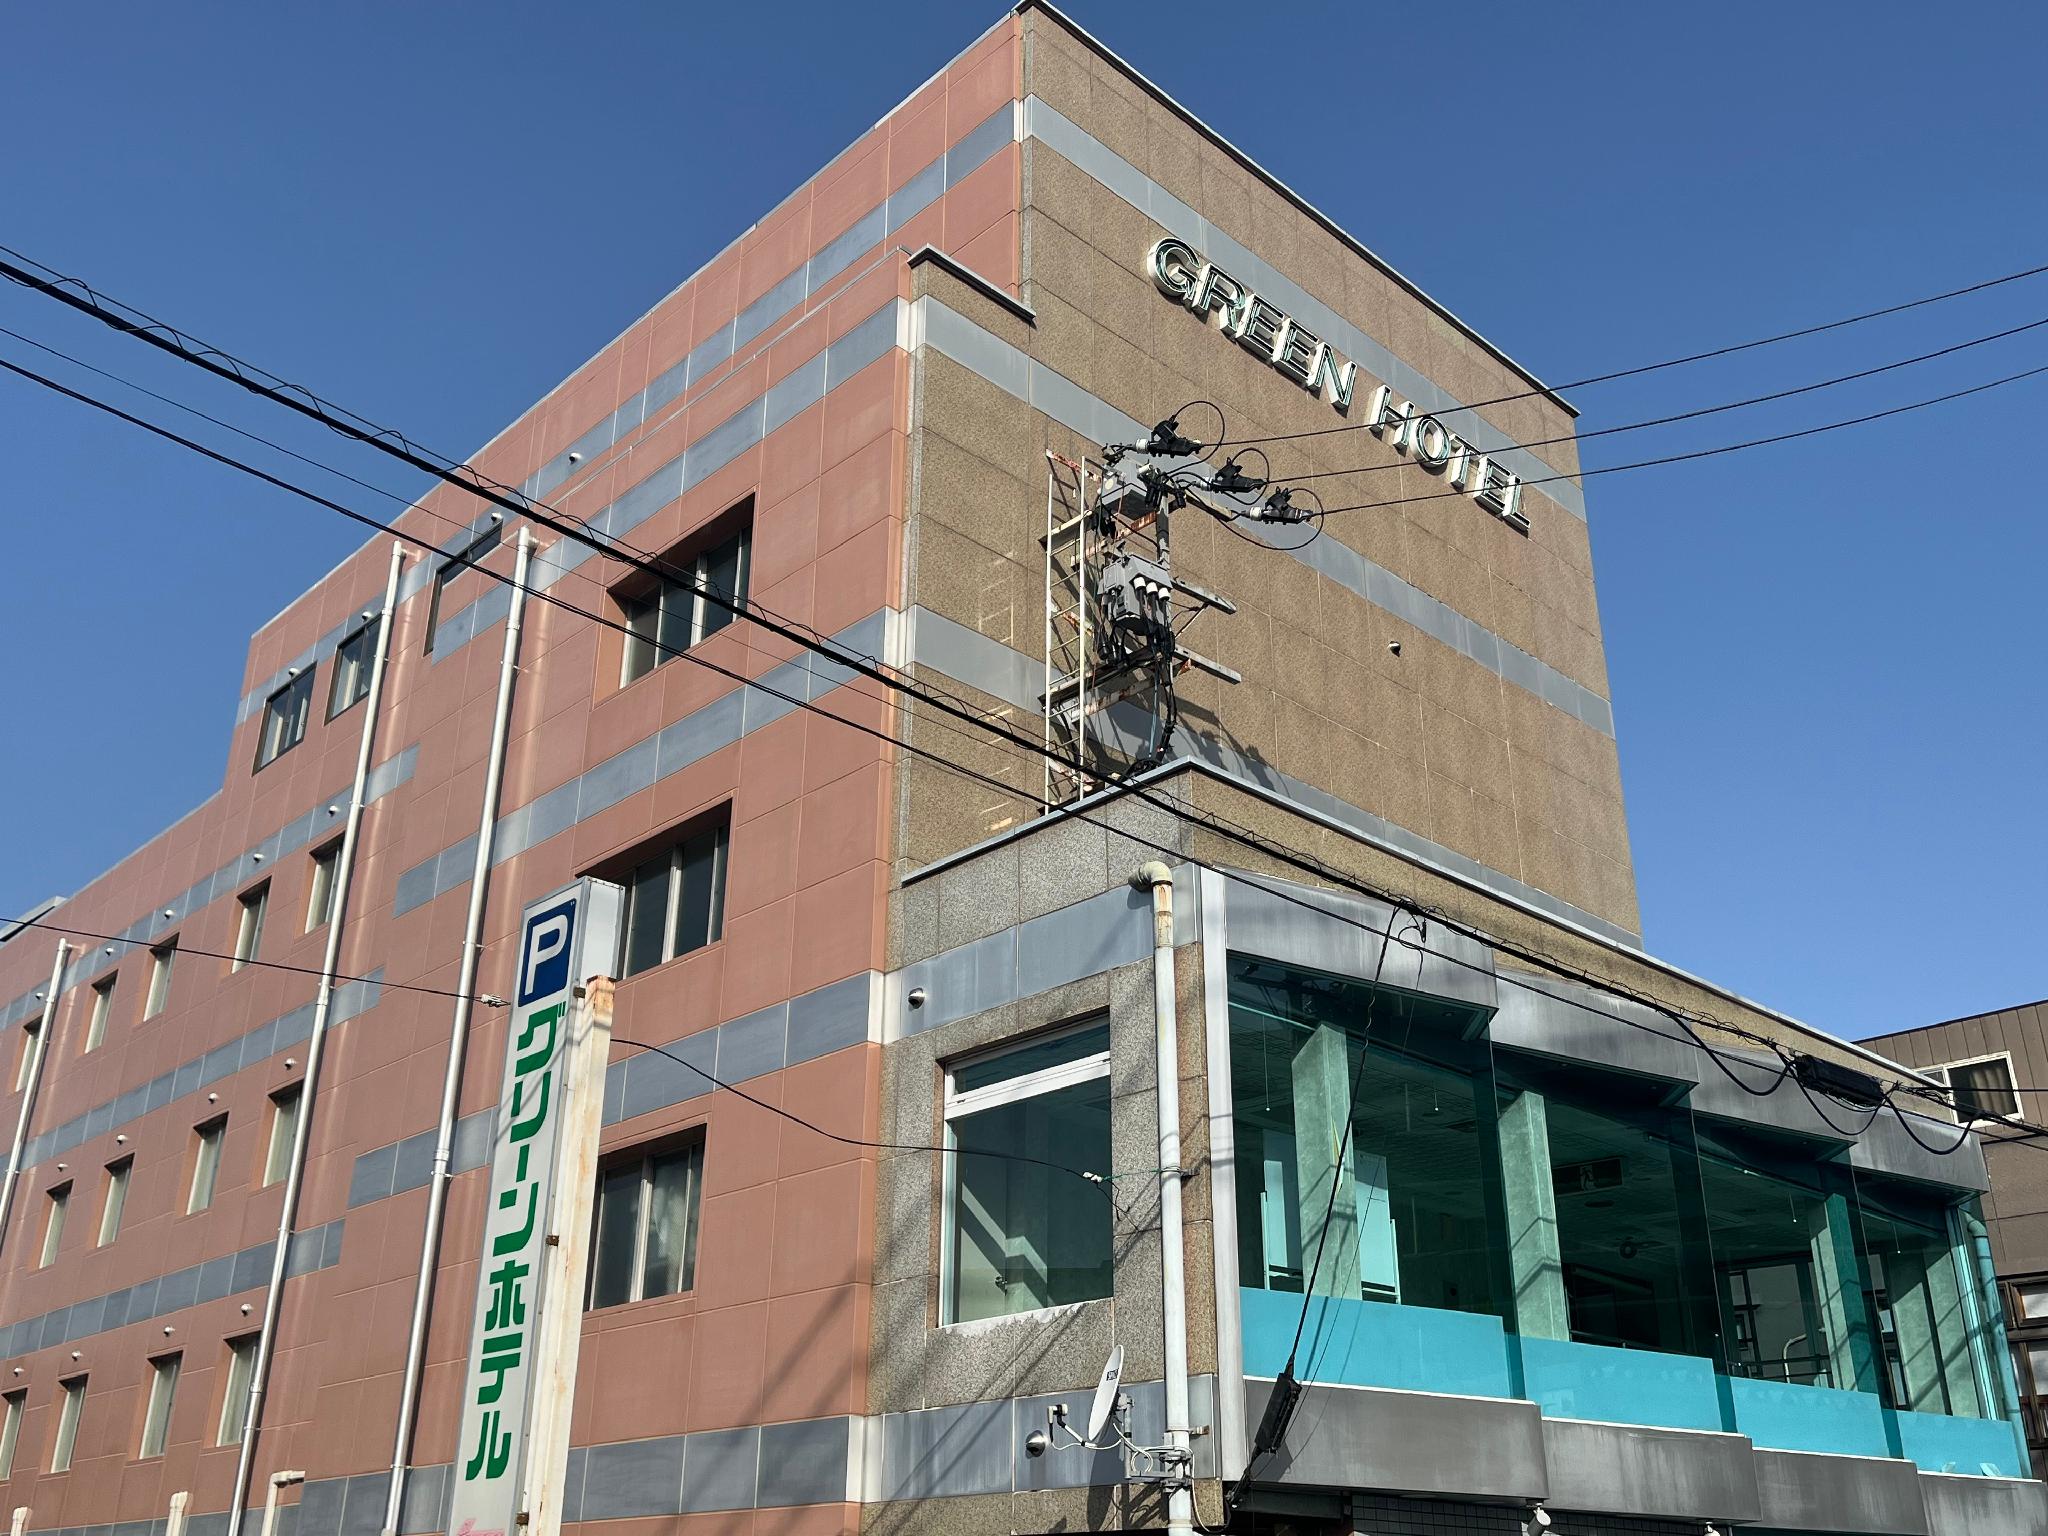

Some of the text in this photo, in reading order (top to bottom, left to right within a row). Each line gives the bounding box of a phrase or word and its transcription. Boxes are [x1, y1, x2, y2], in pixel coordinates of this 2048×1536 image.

[1147, 237, 1531, 534] GREEN HOTEL
[524, 914, 568, 996] P
[465, 1001, 566, 1480] グリーンホテル
